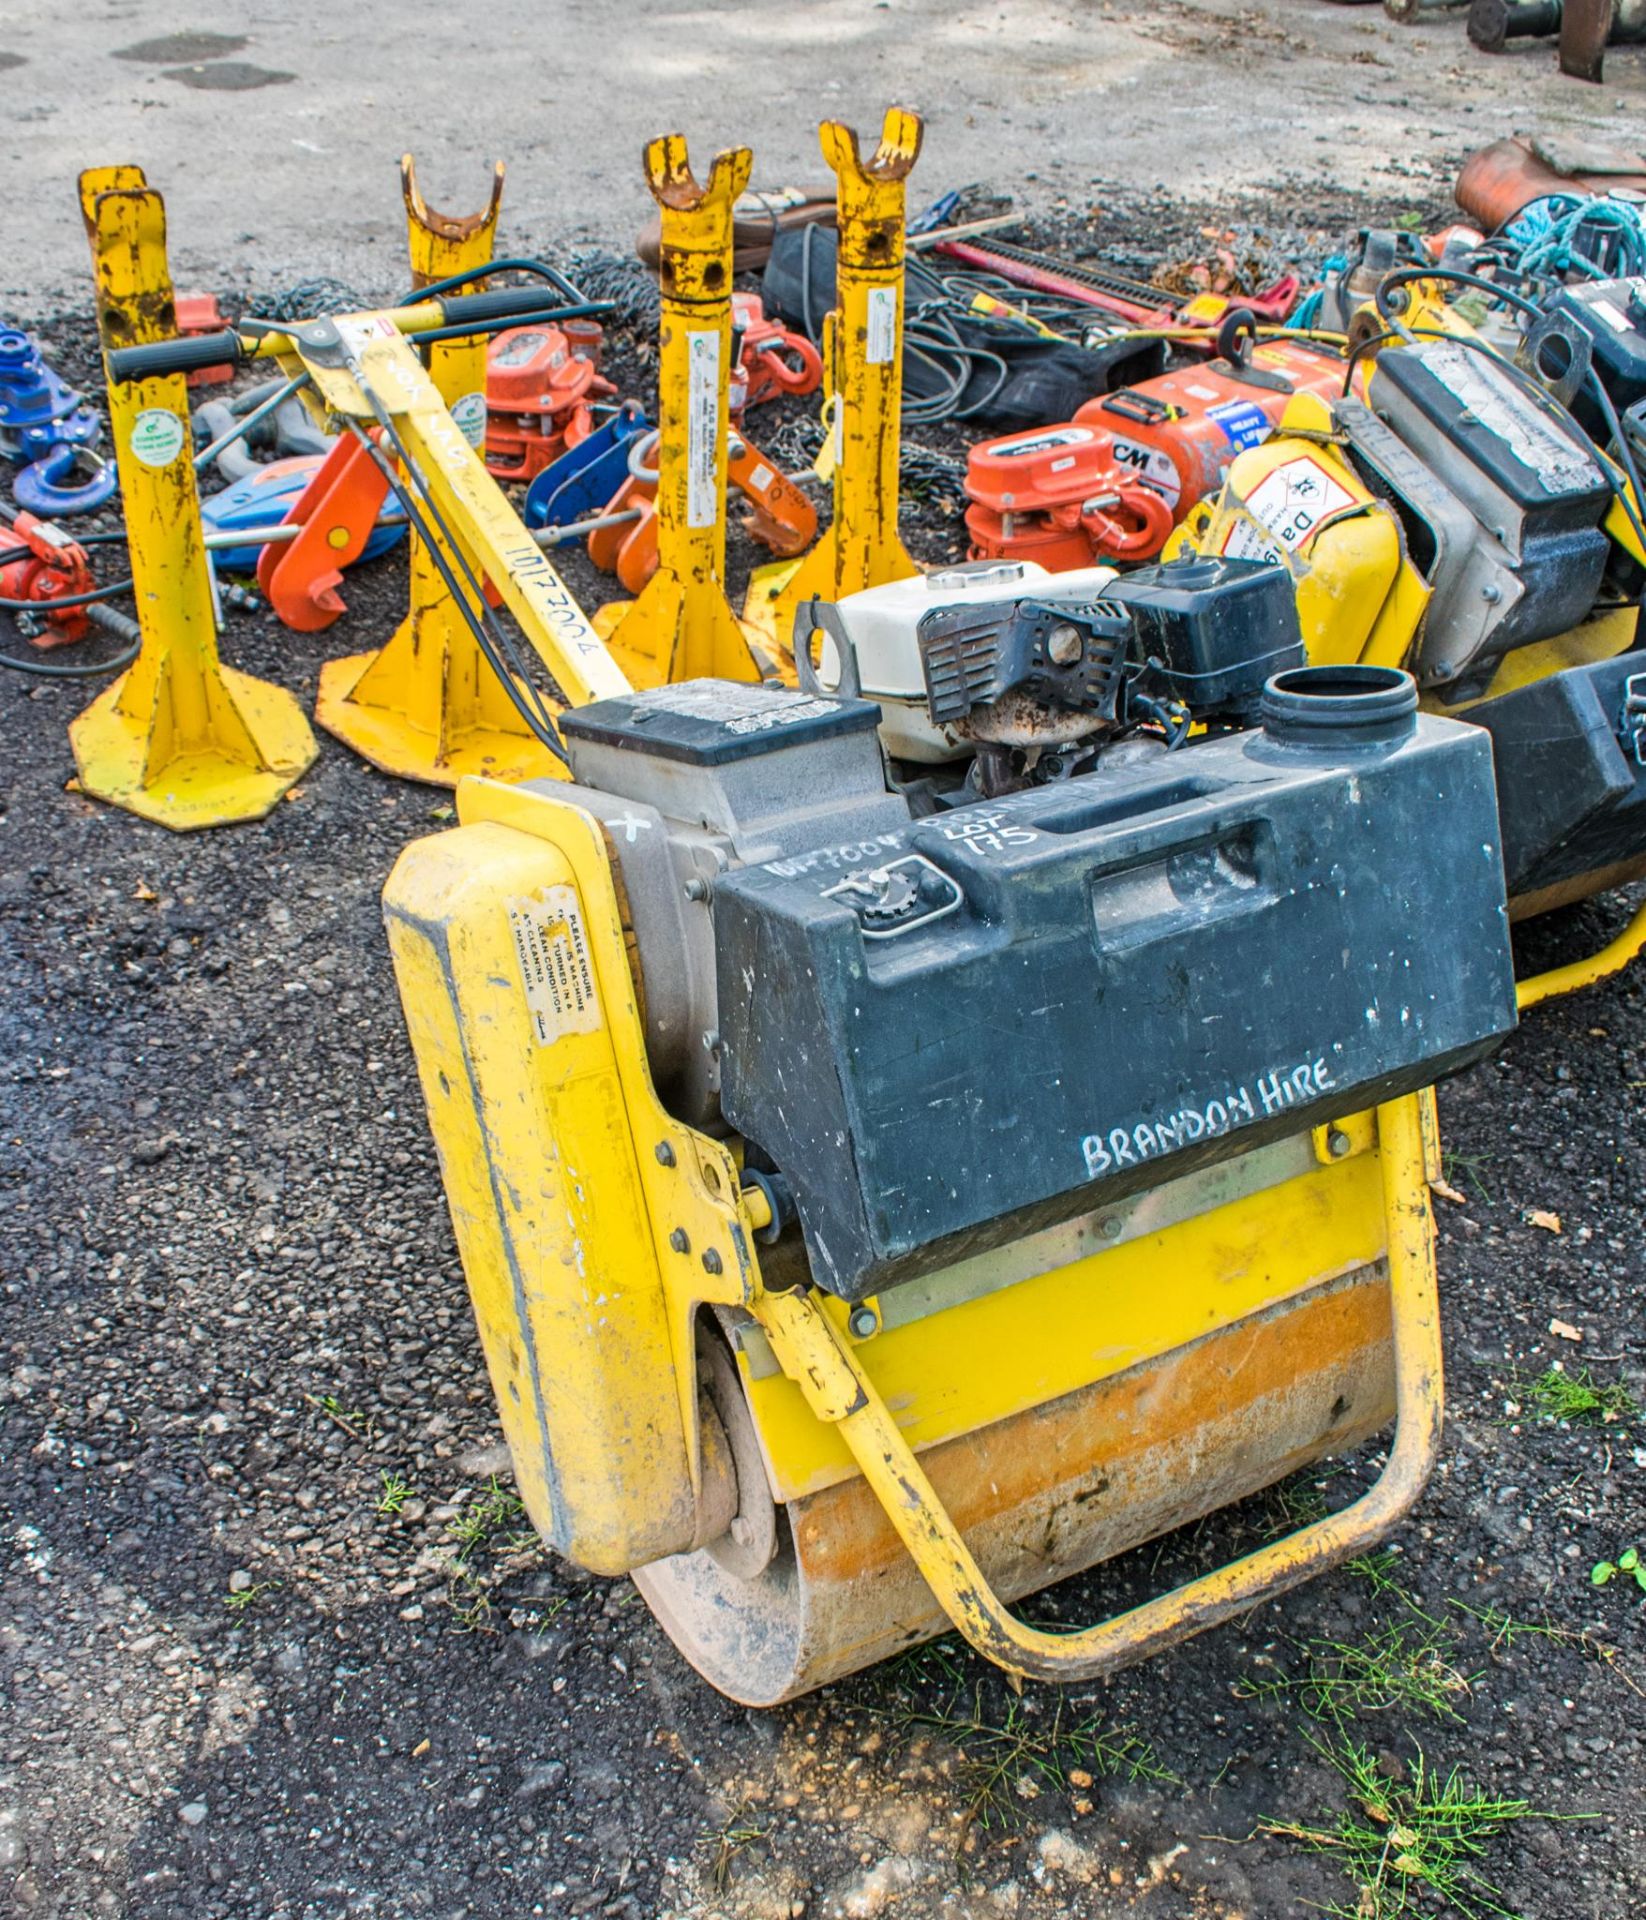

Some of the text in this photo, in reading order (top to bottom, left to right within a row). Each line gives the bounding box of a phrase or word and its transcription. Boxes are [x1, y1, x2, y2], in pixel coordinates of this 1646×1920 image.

[1113, 443, 1151, 471] CM
[943, 813, 1005, 840] LOT
[963, 825, 1038, 856] 175
[513, 929, 536, 993] HARGEABLE
[535, 922, 564, 1014] LEAN CONDITION
[567, 913, 594, 1000] PLEASE ENSURE
[1082, 1058, 1336, 1177] BRANDON HIRE
